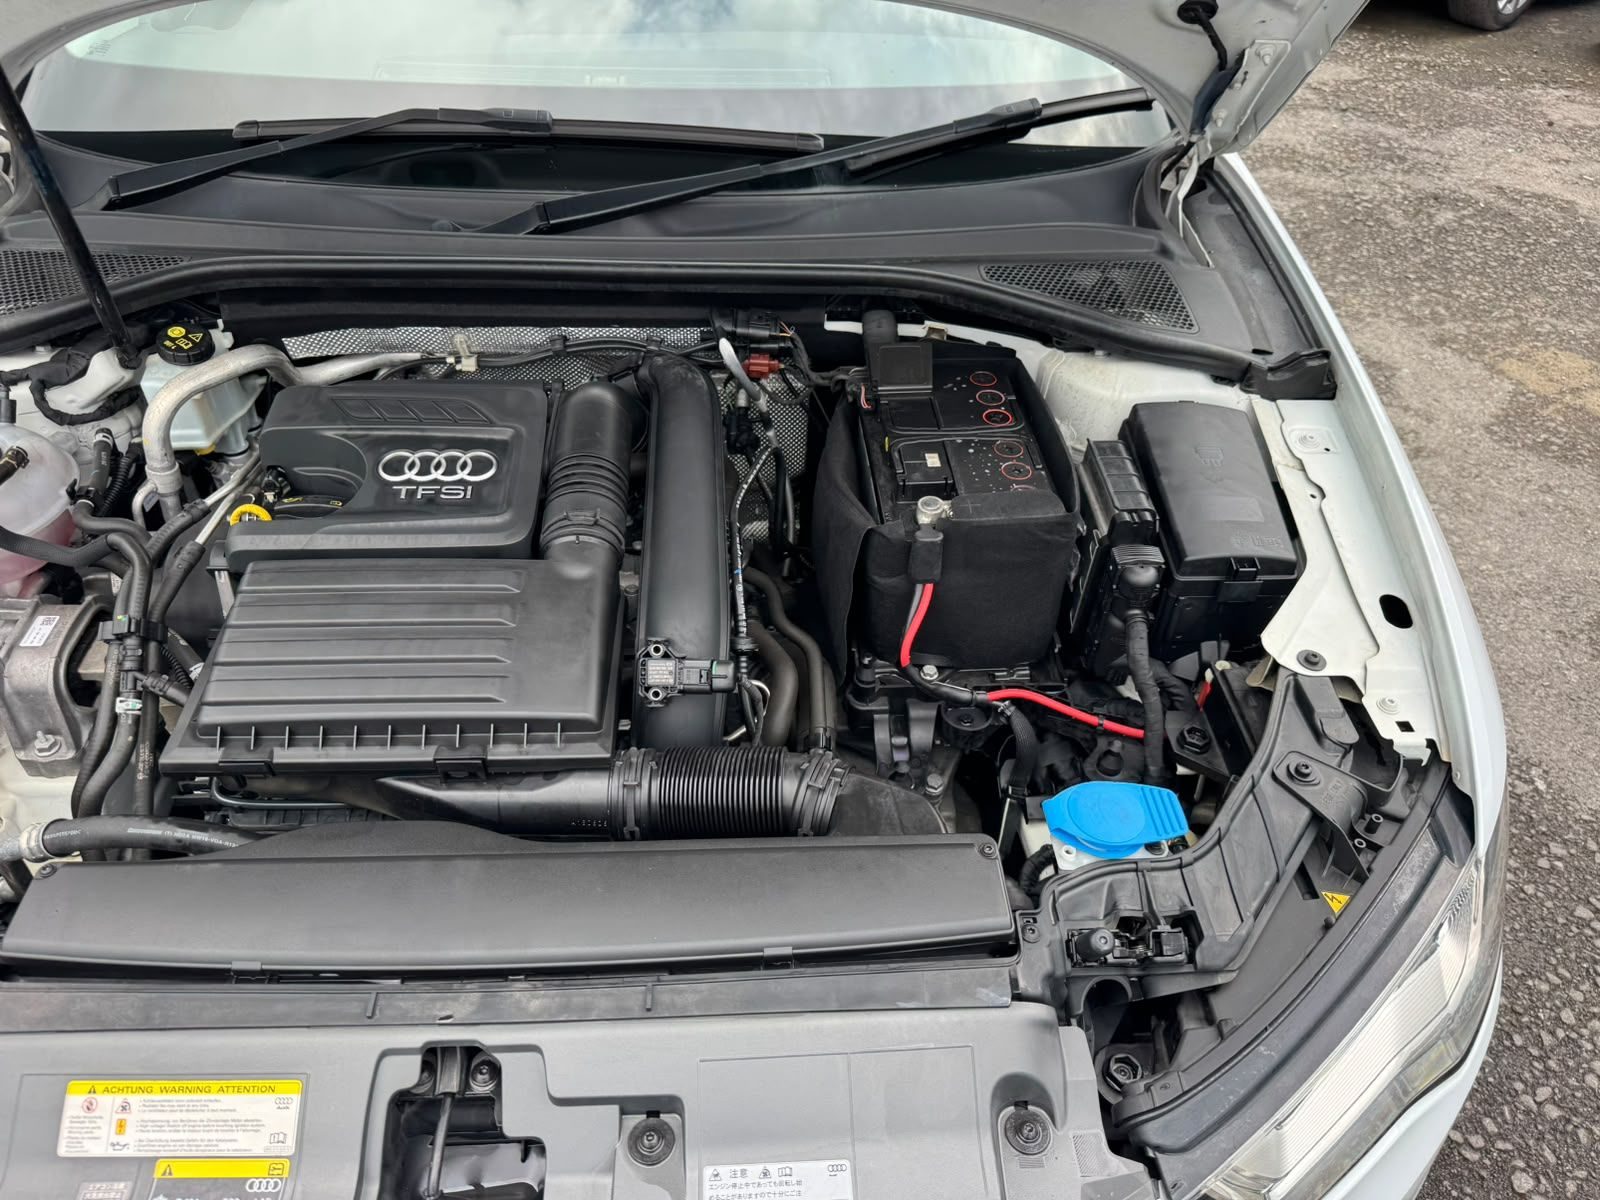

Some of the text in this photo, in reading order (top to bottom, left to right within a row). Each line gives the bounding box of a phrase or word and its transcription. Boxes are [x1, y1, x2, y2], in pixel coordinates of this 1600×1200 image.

[392, 485, 473, 499] TFSI
[102, 1085, 276, 1094] ACHTUNG WARNING ATTENTION
[729, 1168, 748, 1179] 注意
